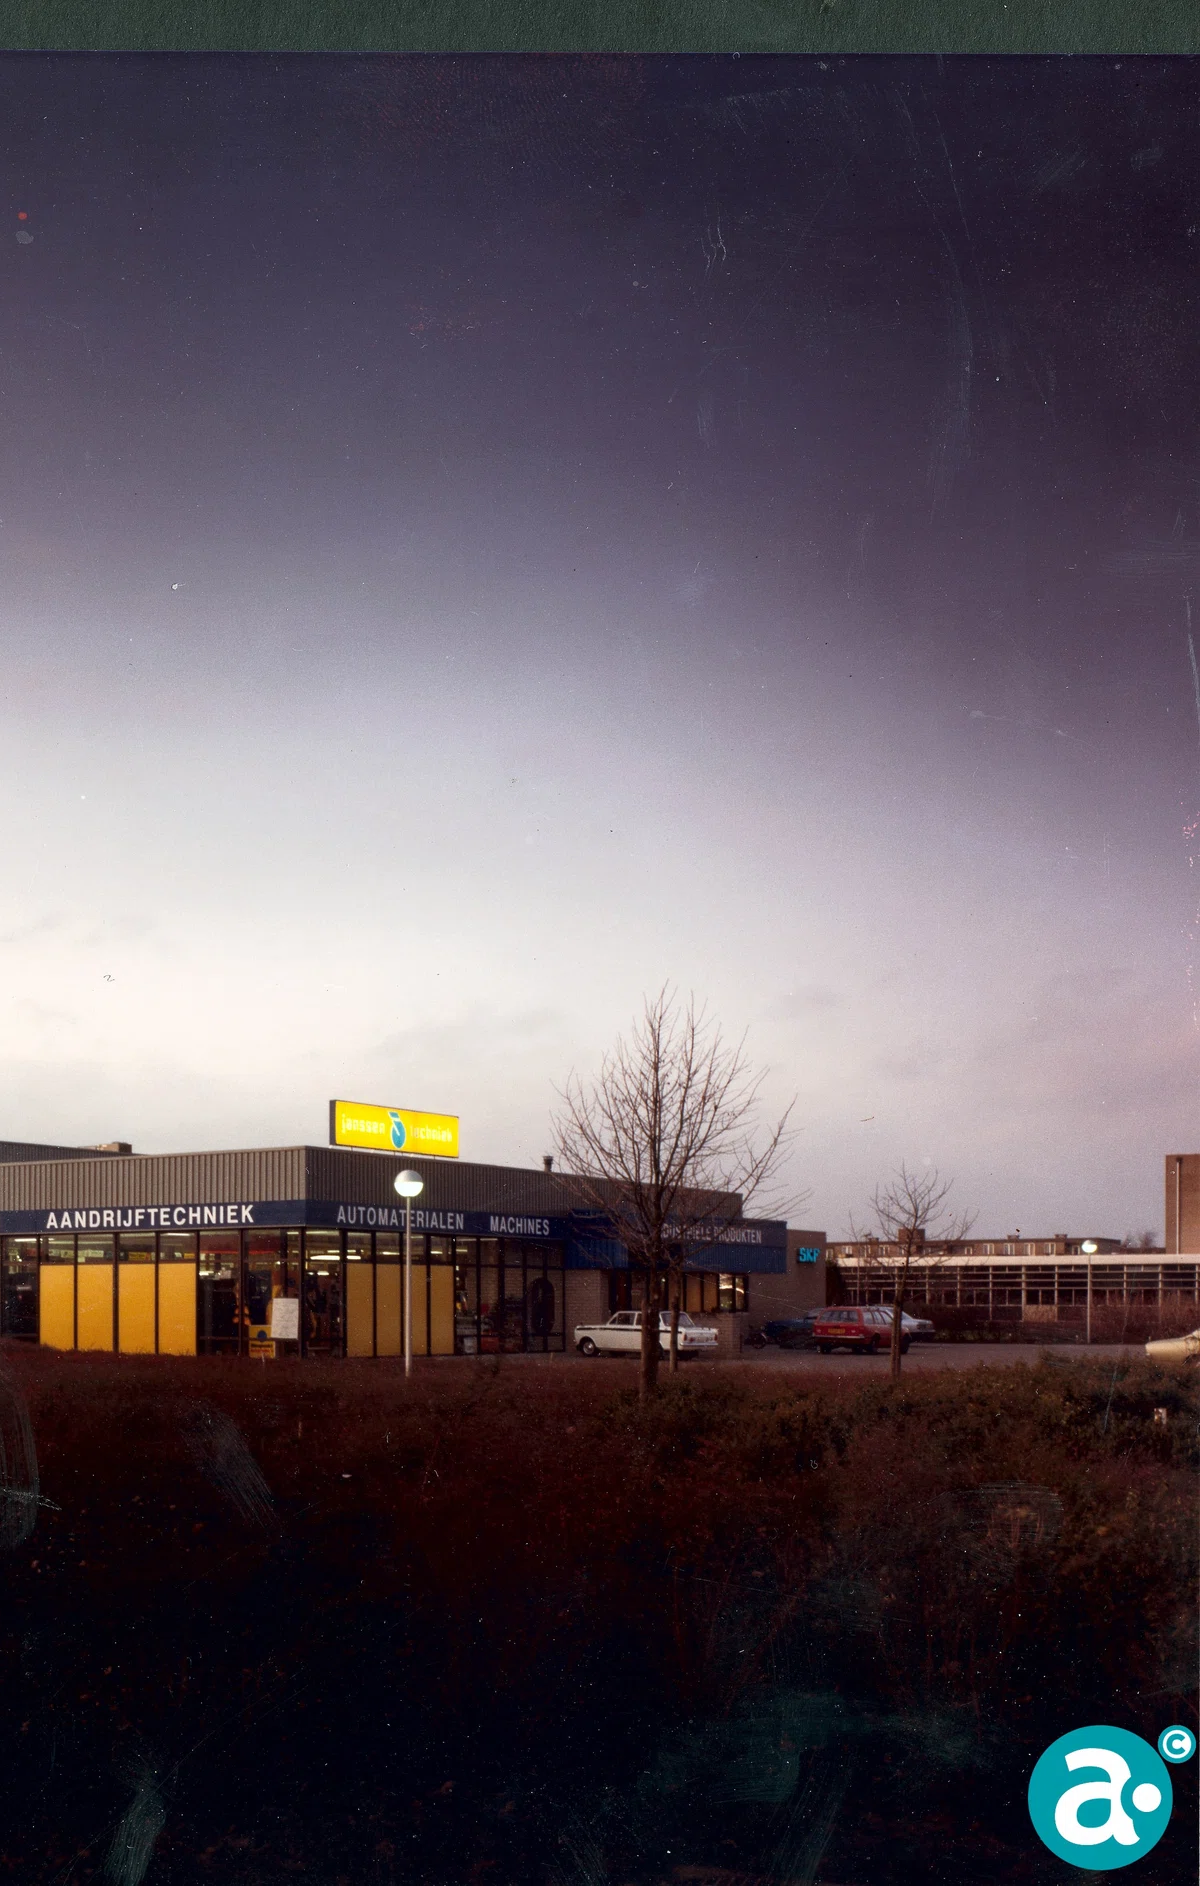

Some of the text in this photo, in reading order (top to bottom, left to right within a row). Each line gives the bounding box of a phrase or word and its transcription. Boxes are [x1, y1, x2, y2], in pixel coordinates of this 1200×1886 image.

[341, 1113, 385, 1135] janssen
[46, 1204, 255, 1229] AANDRIJFTECHNIEK
[336, 1205, 550, 1236] AUTOMATERIALEN MACHINES
[798, 1248, 820, 1263] SKF
